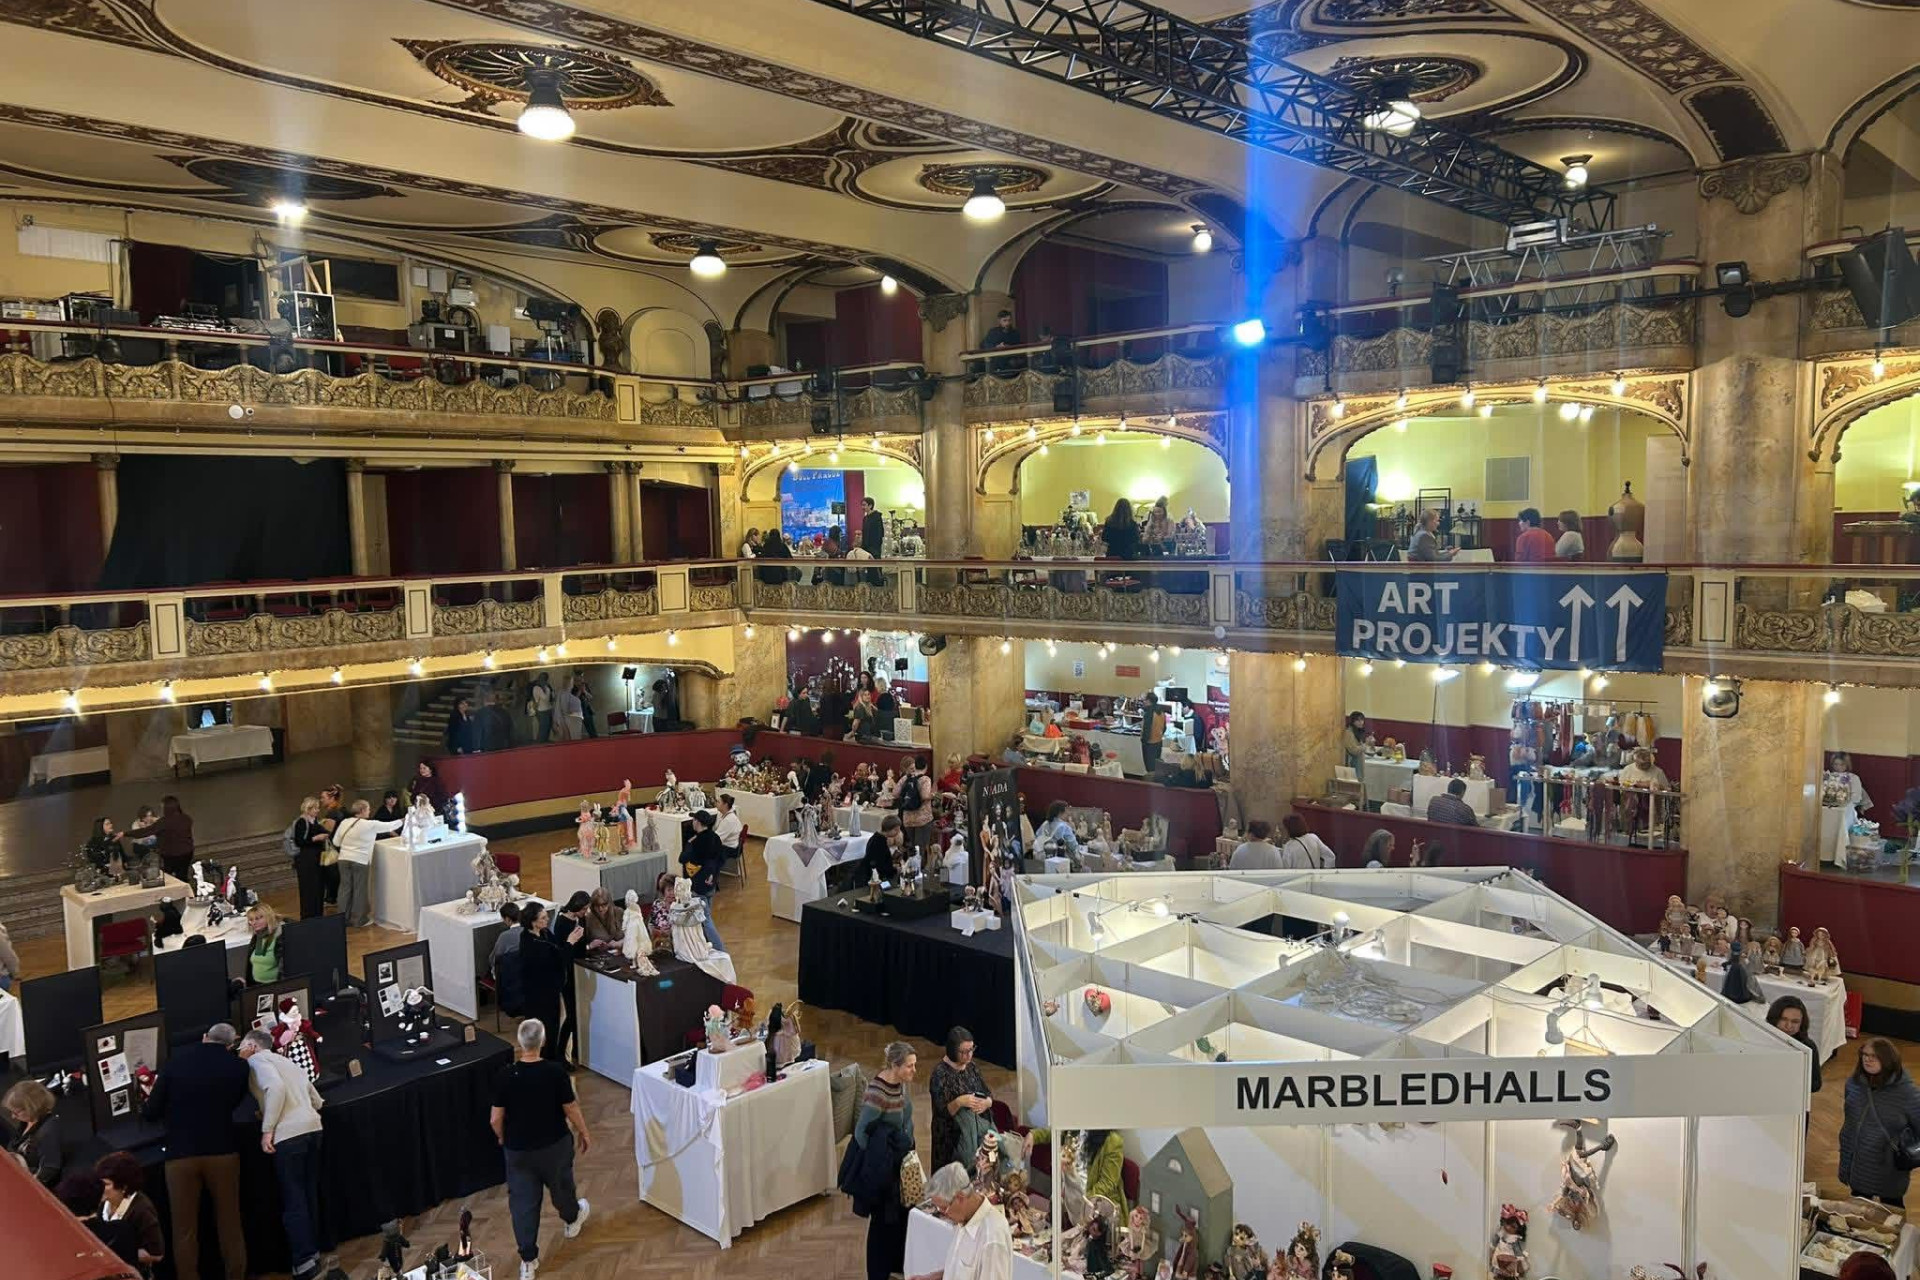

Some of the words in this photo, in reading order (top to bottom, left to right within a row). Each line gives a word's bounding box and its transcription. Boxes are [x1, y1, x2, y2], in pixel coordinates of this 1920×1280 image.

[1377, 581, 1458, 614] ART
[1353, 618, 1565, 660] PROJEKTY
[1237, 1069, 1612, 1109] MARBLEDHALLS
